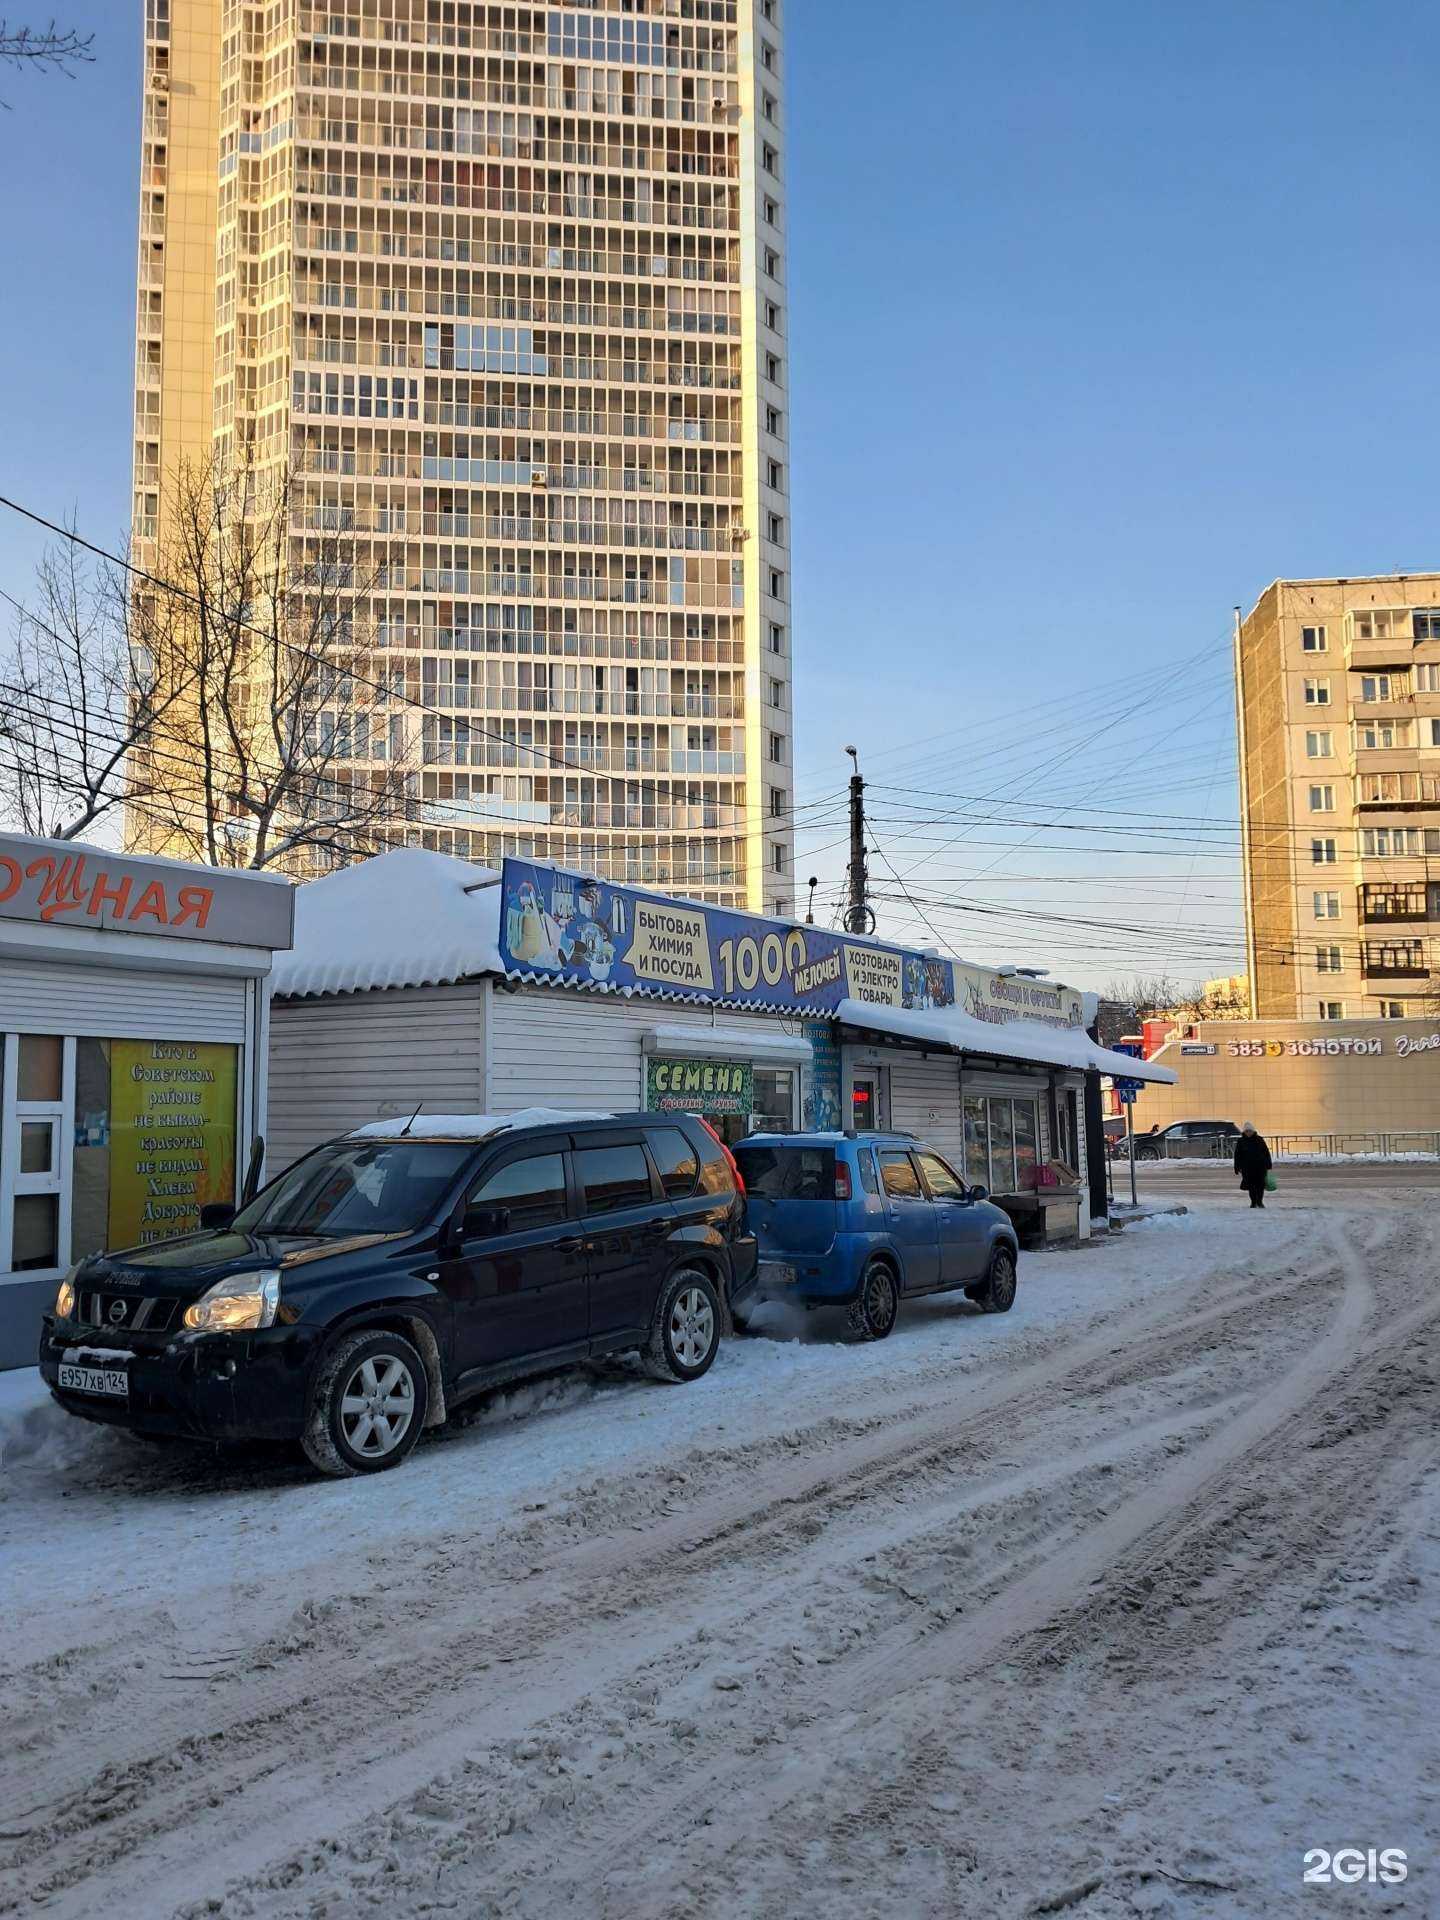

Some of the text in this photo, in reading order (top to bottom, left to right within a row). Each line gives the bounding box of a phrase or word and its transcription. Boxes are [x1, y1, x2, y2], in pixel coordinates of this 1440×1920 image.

[639, 911, 701, 938] БЫТОВАЯ
[648, 934, 693, 957] ХИМИЯ
[639, 955, 703, 980] И ПОСУДА
[719, 930, 842, 995] 1000 МЕЛОЧЕЙ
[849, 951, 900, 974] ХОЗТОВАРЫ
[853, 970, 899, 990] И ЭЛЕКТРО
[858, 988, 893, 1006] ТОВАРЫ
[152, 1042, 184, 1060] Кто
[1226, 1040, 1263, 1057] 585
[1286, 1037, 1382, 1056] ЗОЛОТОЙ
[131, 1064, 215, 1082] Советском
[656, 1065, 743, 1092] СЕМЕНА
[149, 1088, 202, 1109] районе
[134, 1114, 153, 1128] не
[140, 1137, 204, 1155] красоты
[136, 1161, 156, 1174] не
[147, 1178, 197, 1196] Хлеба
[141, 1202, 201, 1225] Доброго
[61, 1368, 125, 1390] Е957ХВ 124
